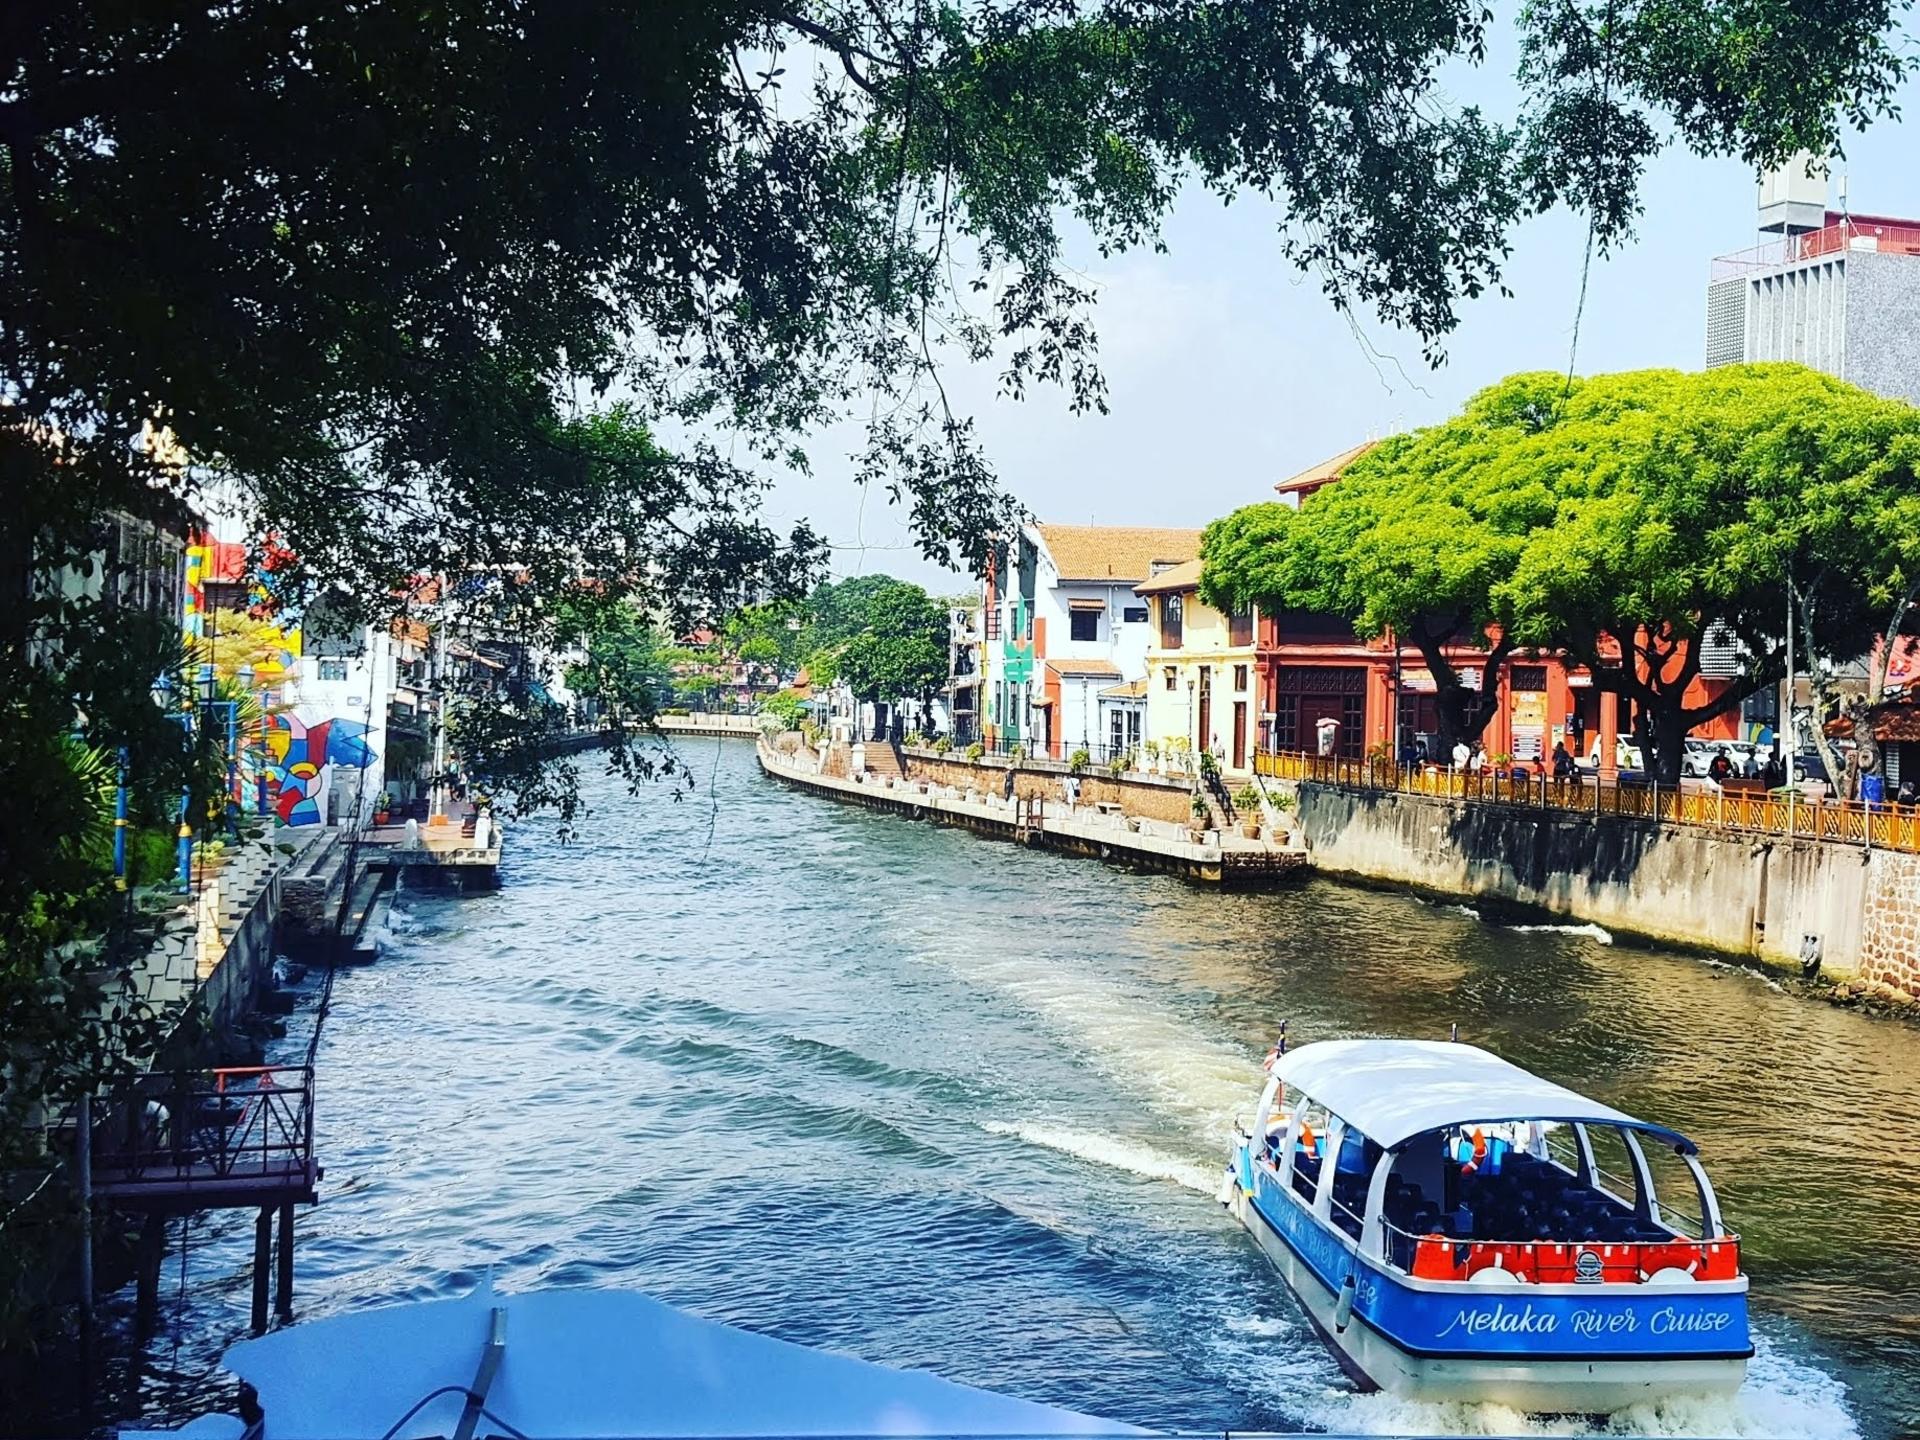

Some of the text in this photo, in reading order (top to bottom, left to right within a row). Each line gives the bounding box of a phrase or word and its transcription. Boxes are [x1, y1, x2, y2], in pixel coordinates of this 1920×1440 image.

[1435, 1302, 1735, 1339] Melaka River Cruise
